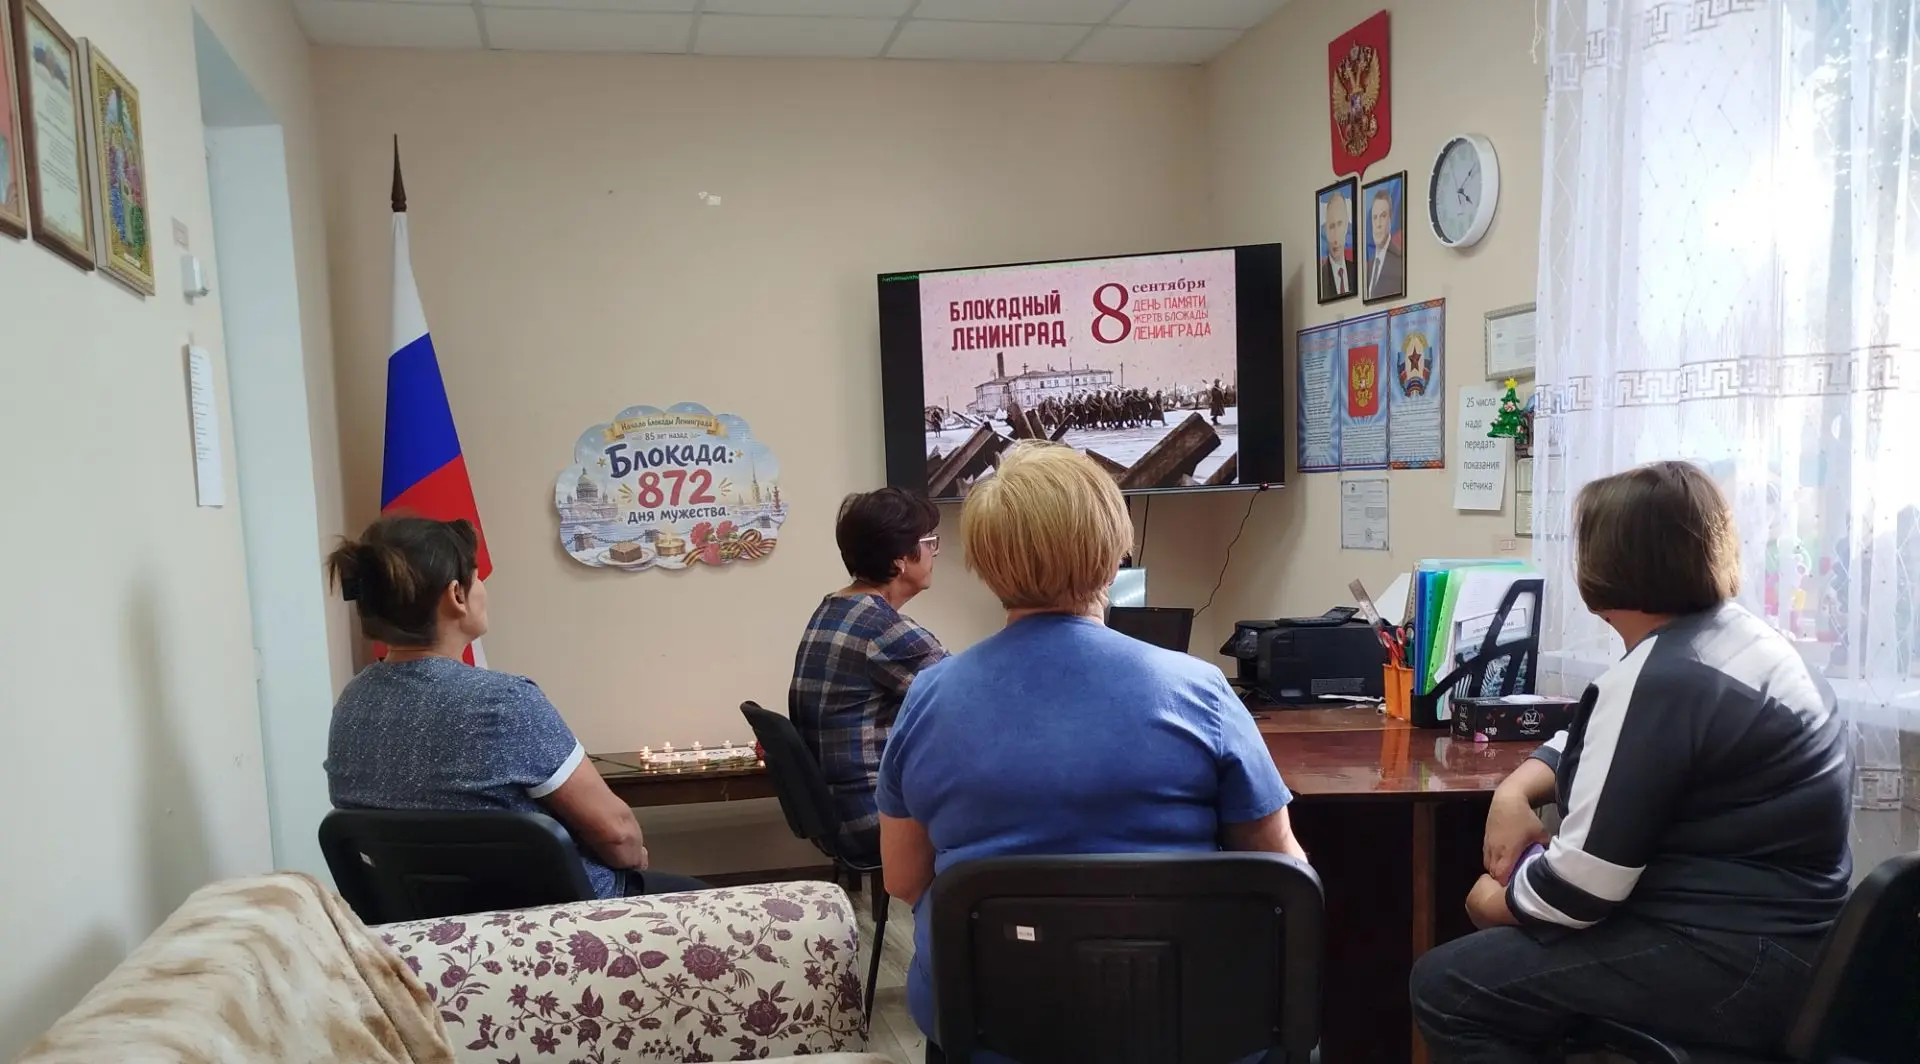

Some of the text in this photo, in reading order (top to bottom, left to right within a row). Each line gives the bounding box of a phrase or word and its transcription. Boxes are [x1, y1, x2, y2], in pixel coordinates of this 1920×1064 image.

[1132, 277, 1206, 293] сентября
[950, 290, 1061, 321] БЛОКАДНЫЙ
[1132, 294, 1206, 312] ДЕНЬ ПАМЯТИ
[1091, 282, 1132, 344] 8
[1134, 309, 1209, 324] ЖЕРТВ БЛОКАДЫ
[951, 321, 1067, 351] ЛЕНИНГРАД
[1134, 322, 1211, 342] ЛЕНИНГРАДА
[1466, 397, 1496, 408] 25 числа
[1465, 420, 1482, 429] надо
[645, 432, 655, 441] 85
[1464, 440, 1496, 450] передать
[604, 443, 734, 478] Блокада:
[1463, 461, 1500, 470] показания
[638, 469, 716, 508] 872
[628, 506, 730, 524] дня мужества.
